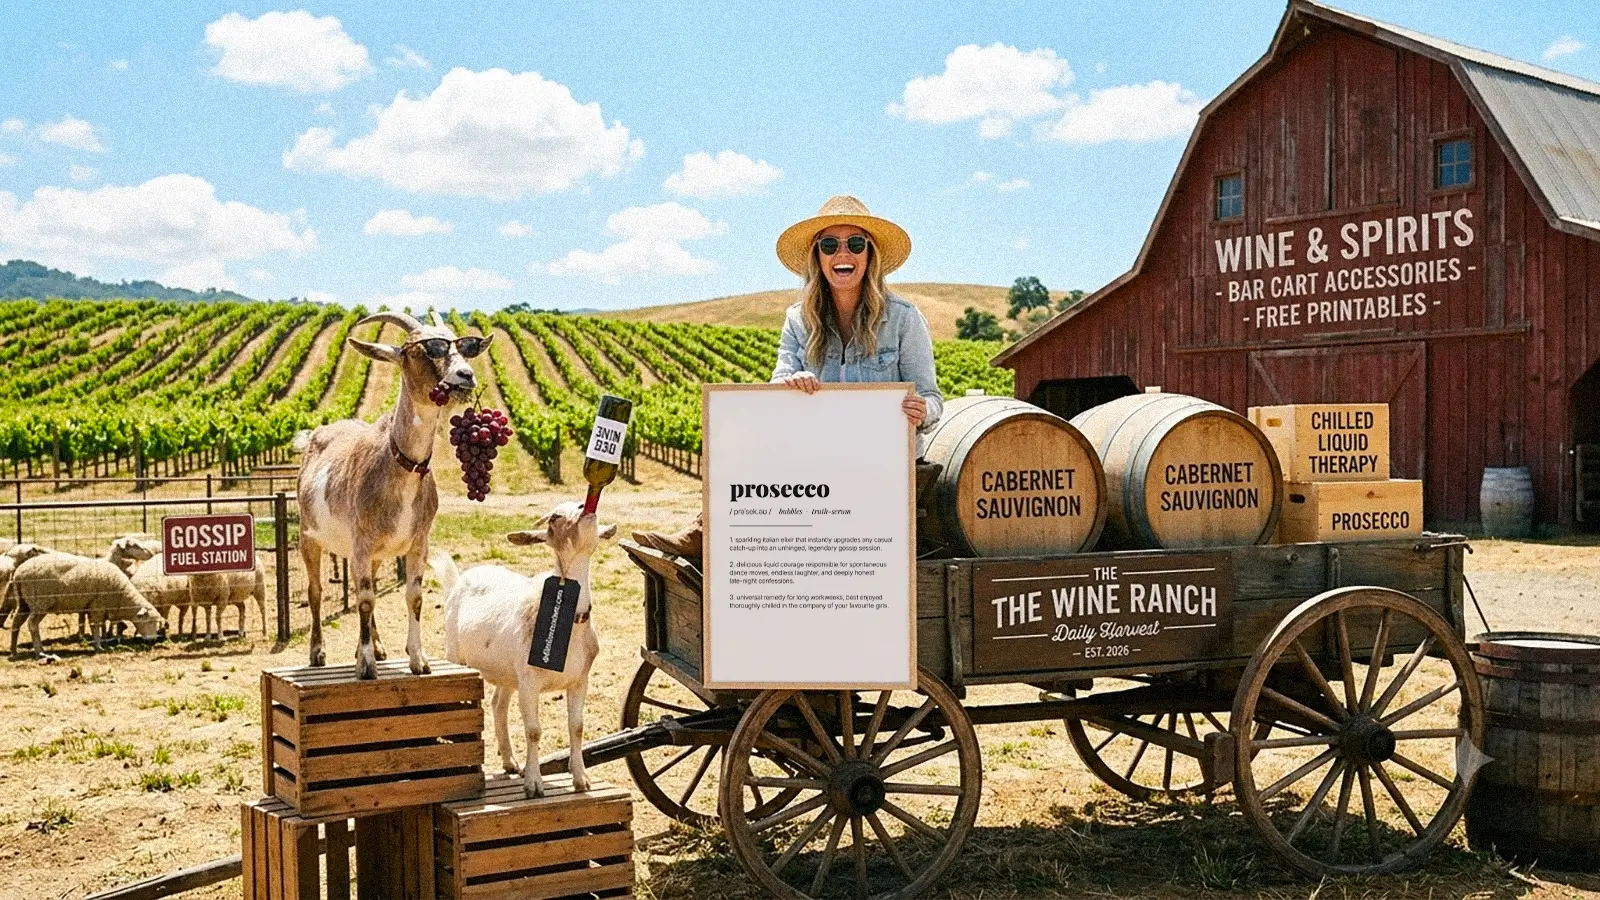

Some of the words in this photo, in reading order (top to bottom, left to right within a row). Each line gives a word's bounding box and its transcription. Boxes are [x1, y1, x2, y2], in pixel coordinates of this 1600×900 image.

[1215, 230, 1295, 273] WINE
[1306, 227, 1329, 264] &
[1340, 208, 1474, 260] SPIRITS
[1229, 279, 1264, 302] BAR
[1270, 272, 1318, 298] CART
[1324, 258, 1461, 292] ACCESSORIES
[1256, 304, 1300, 328] FREE
[1307, 292, 1426, 324] PRINTABLES
[1312, 412, 1374, 430] CHILLED
[1319, 434, 1368, 452] LIQUID
[1165, 462, 1253, 486] CABERNET
[1309, 455, 1378, 473] THERAPY
[982, 469, 1076, 492] CABERNET
[730, 484, 830, 502] prosecco
[1161, 488, 1258, 512] SAUVIGNON
[976, 495, 1080, 519] SAUVIGNON
[1332, 511, 1409, 530] PROSECCO
[170, 523, 246, 548] GOSSIP
[171, 552, 199, 565] FUEL
[202, 550, 247, 564] STATION
[1093, 567, 1118, 581] THE
[992, 591, 1042, 628] THE
[1051, 584, 1120, 618] WINE
[1130, 583, 1216, 617] RANCH
[1051, 624, 1097, 644] Daily
[1100, 620, 1160, 640] Harvest
[1085, 647, 1105, 658] EST.
[1107, 645, 1129, 656] 2026
